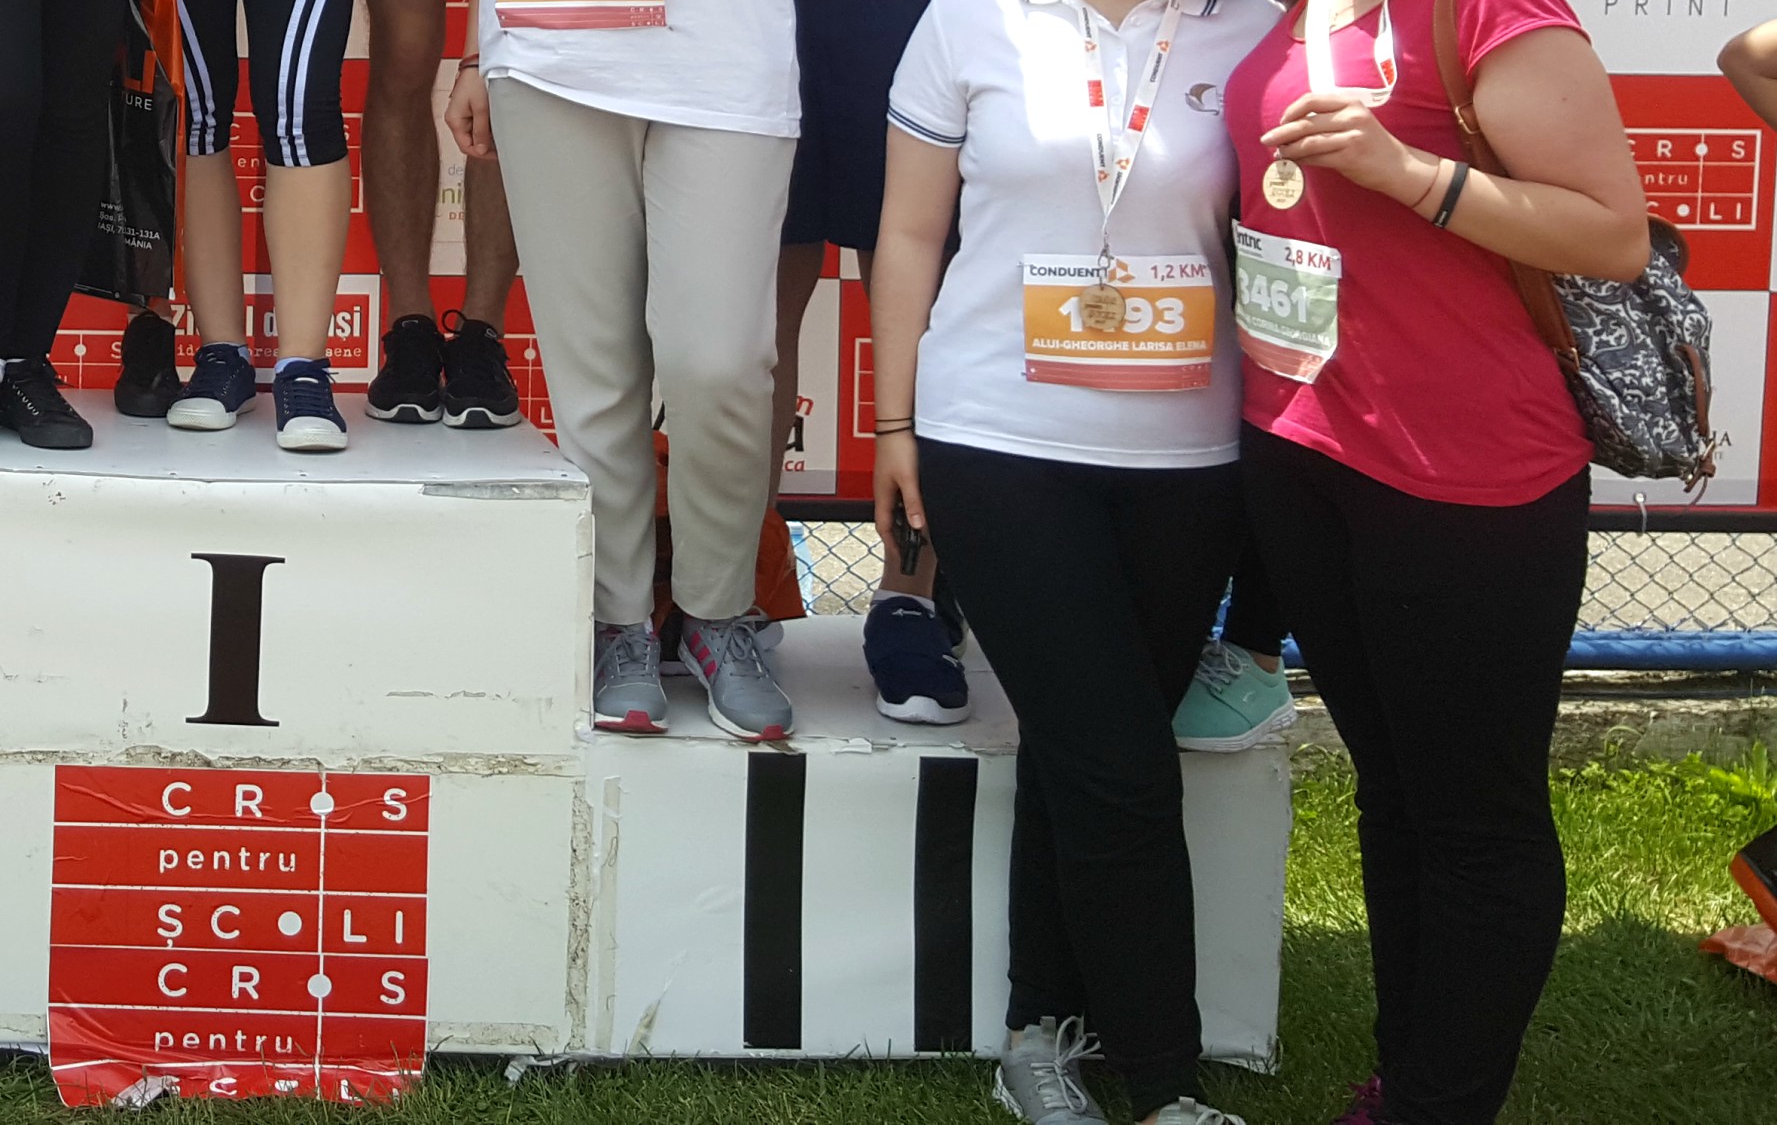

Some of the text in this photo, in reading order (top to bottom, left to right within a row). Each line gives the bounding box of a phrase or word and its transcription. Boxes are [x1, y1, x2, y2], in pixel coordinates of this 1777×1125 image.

[1284, 246, 1332, 272] 2,8 KM
[1029, 263, 1205, 283] CONDUENT 1,2 KM
[1237, 267, 1308, 324] 3461
[1058, 296, 1186, 335] 193
[1031, 338, 1207, 352] ALUI-GHEORGHE LARISA ELENA
[185, 552, 286, 728] I
[158, 847, 298, 874] pentru
[154, 1027, 295, 1054] pentru
